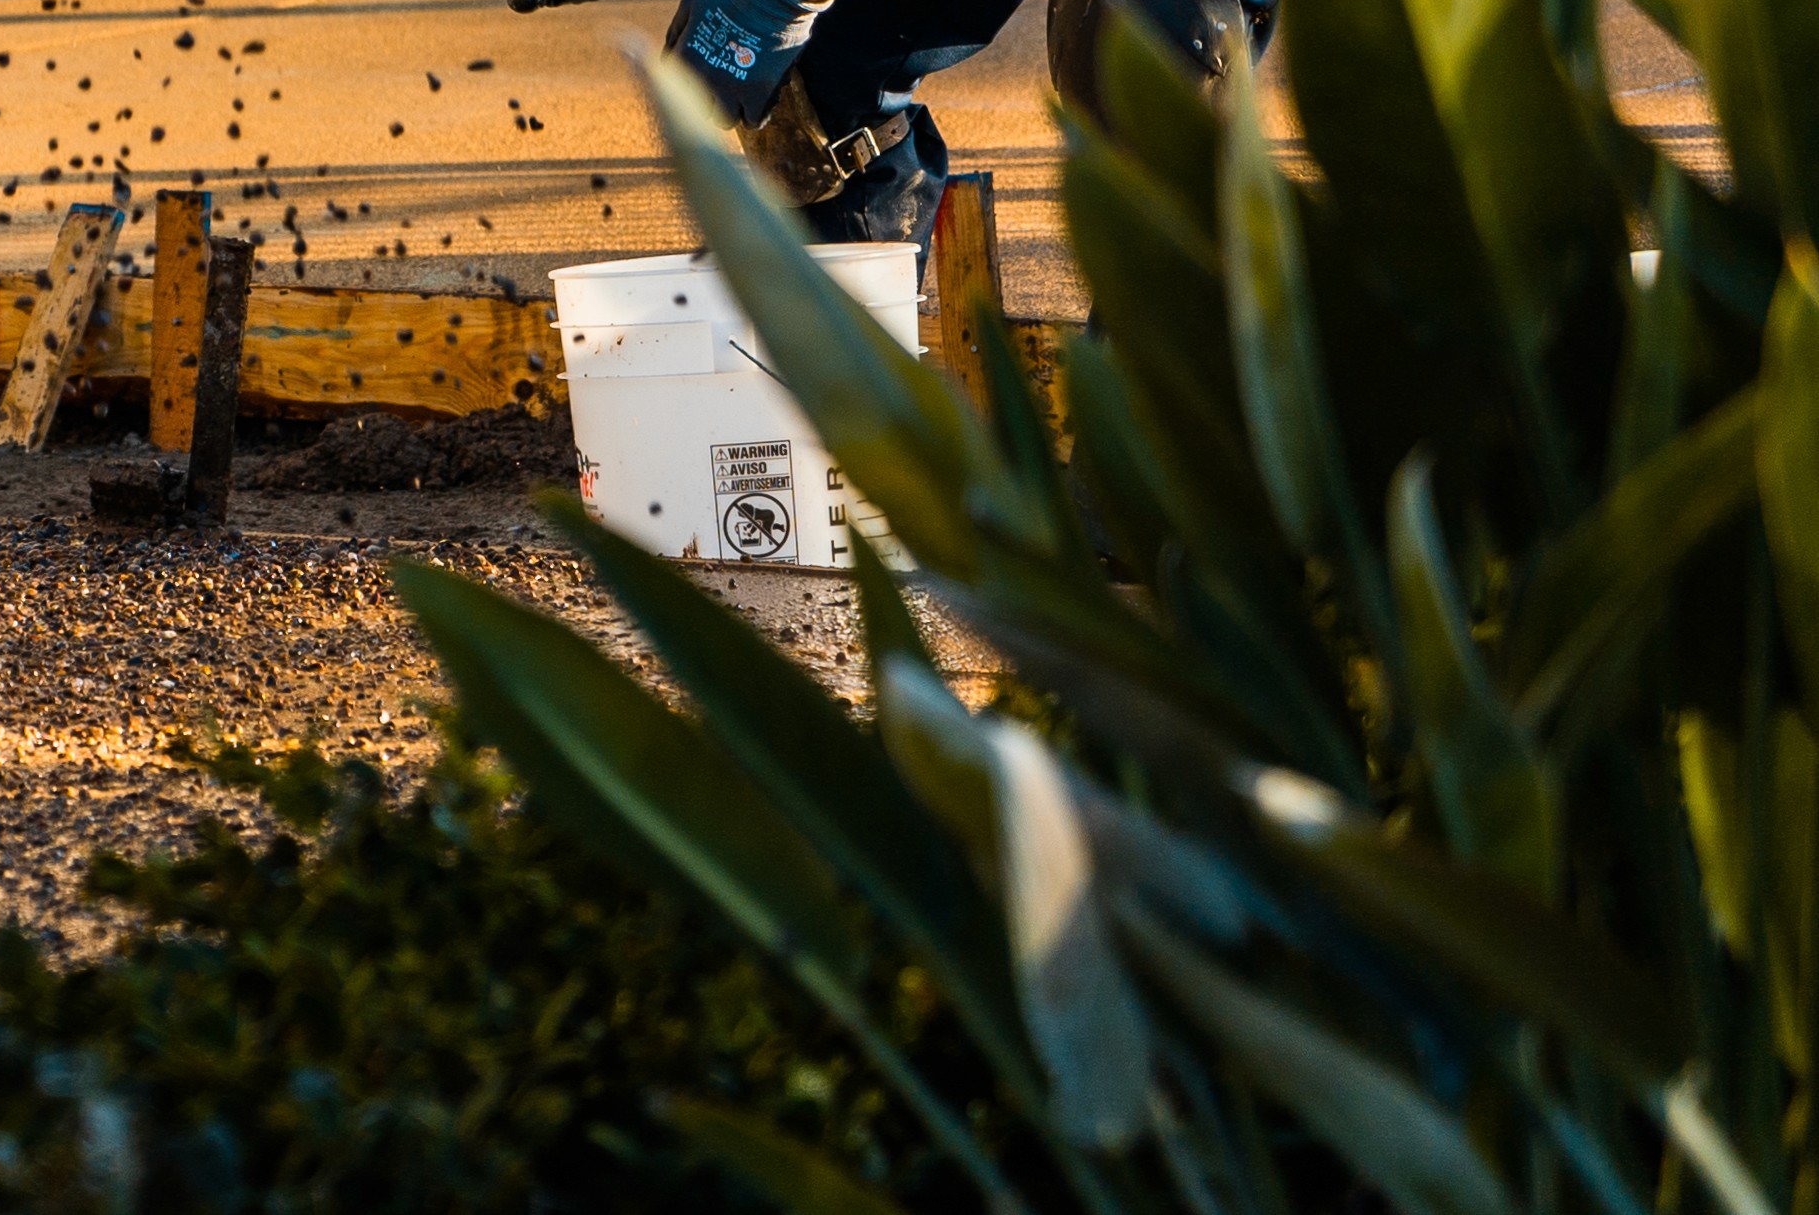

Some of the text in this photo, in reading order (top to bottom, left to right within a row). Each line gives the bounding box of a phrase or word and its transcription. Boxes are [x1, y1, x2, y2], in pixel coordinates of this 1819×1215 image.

[728, 444, 788, 460] WARNING
[730, 461, 768, 476] AVISO
[730, 476, 790, 492] AVERTISSEMENT
